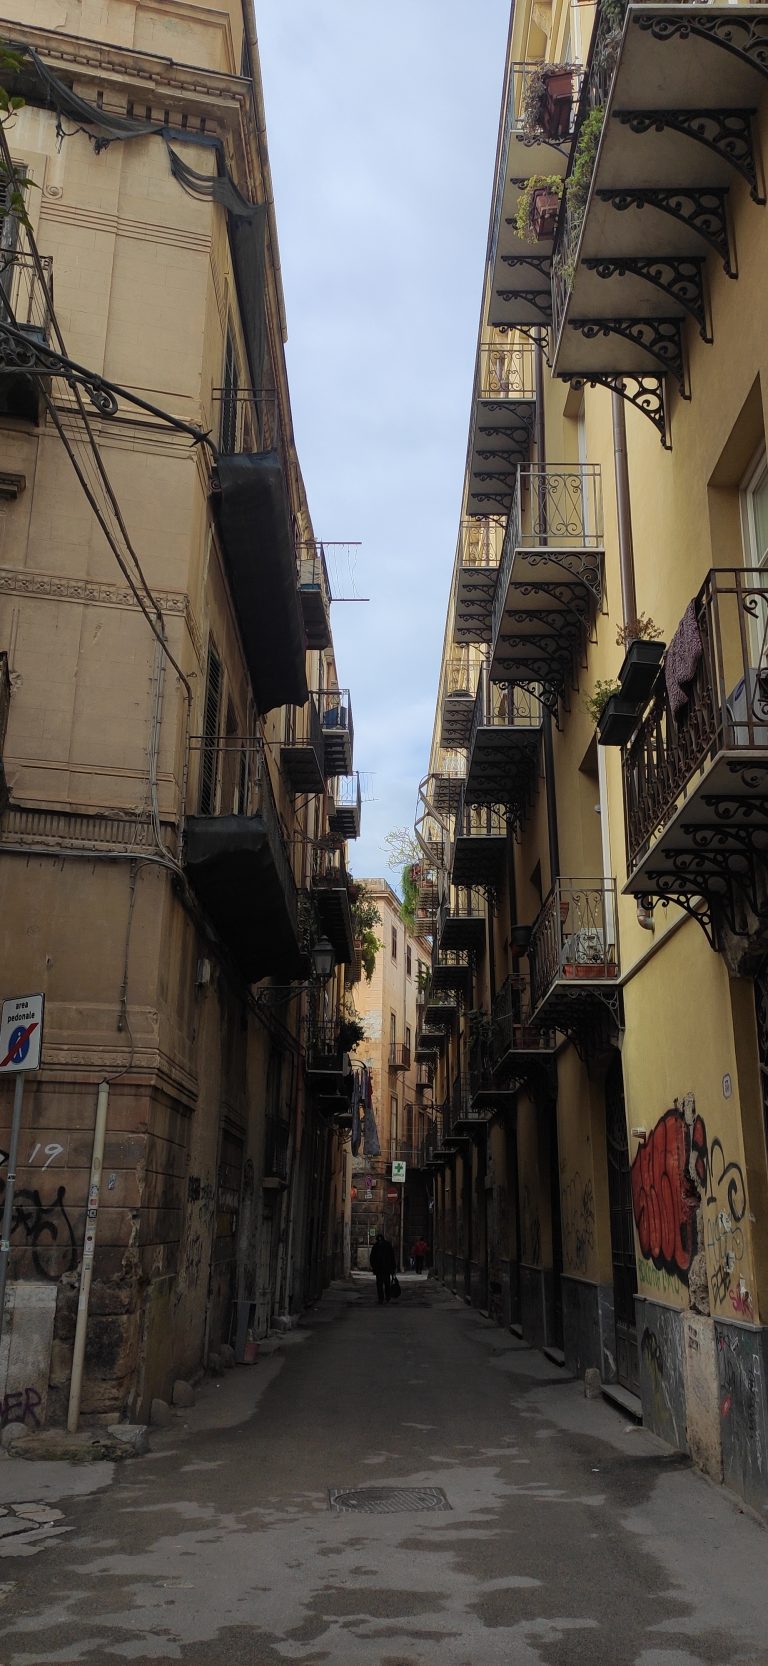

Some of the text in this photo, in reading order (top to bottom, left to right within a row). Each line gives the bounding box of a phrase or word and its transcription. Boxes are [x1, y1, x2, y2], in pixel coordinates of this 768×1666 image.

[15, 1001, 29, 1010] area
[7, 1011, 36, 1024] pedonale
[28, 1143, 65, 1171] 19
